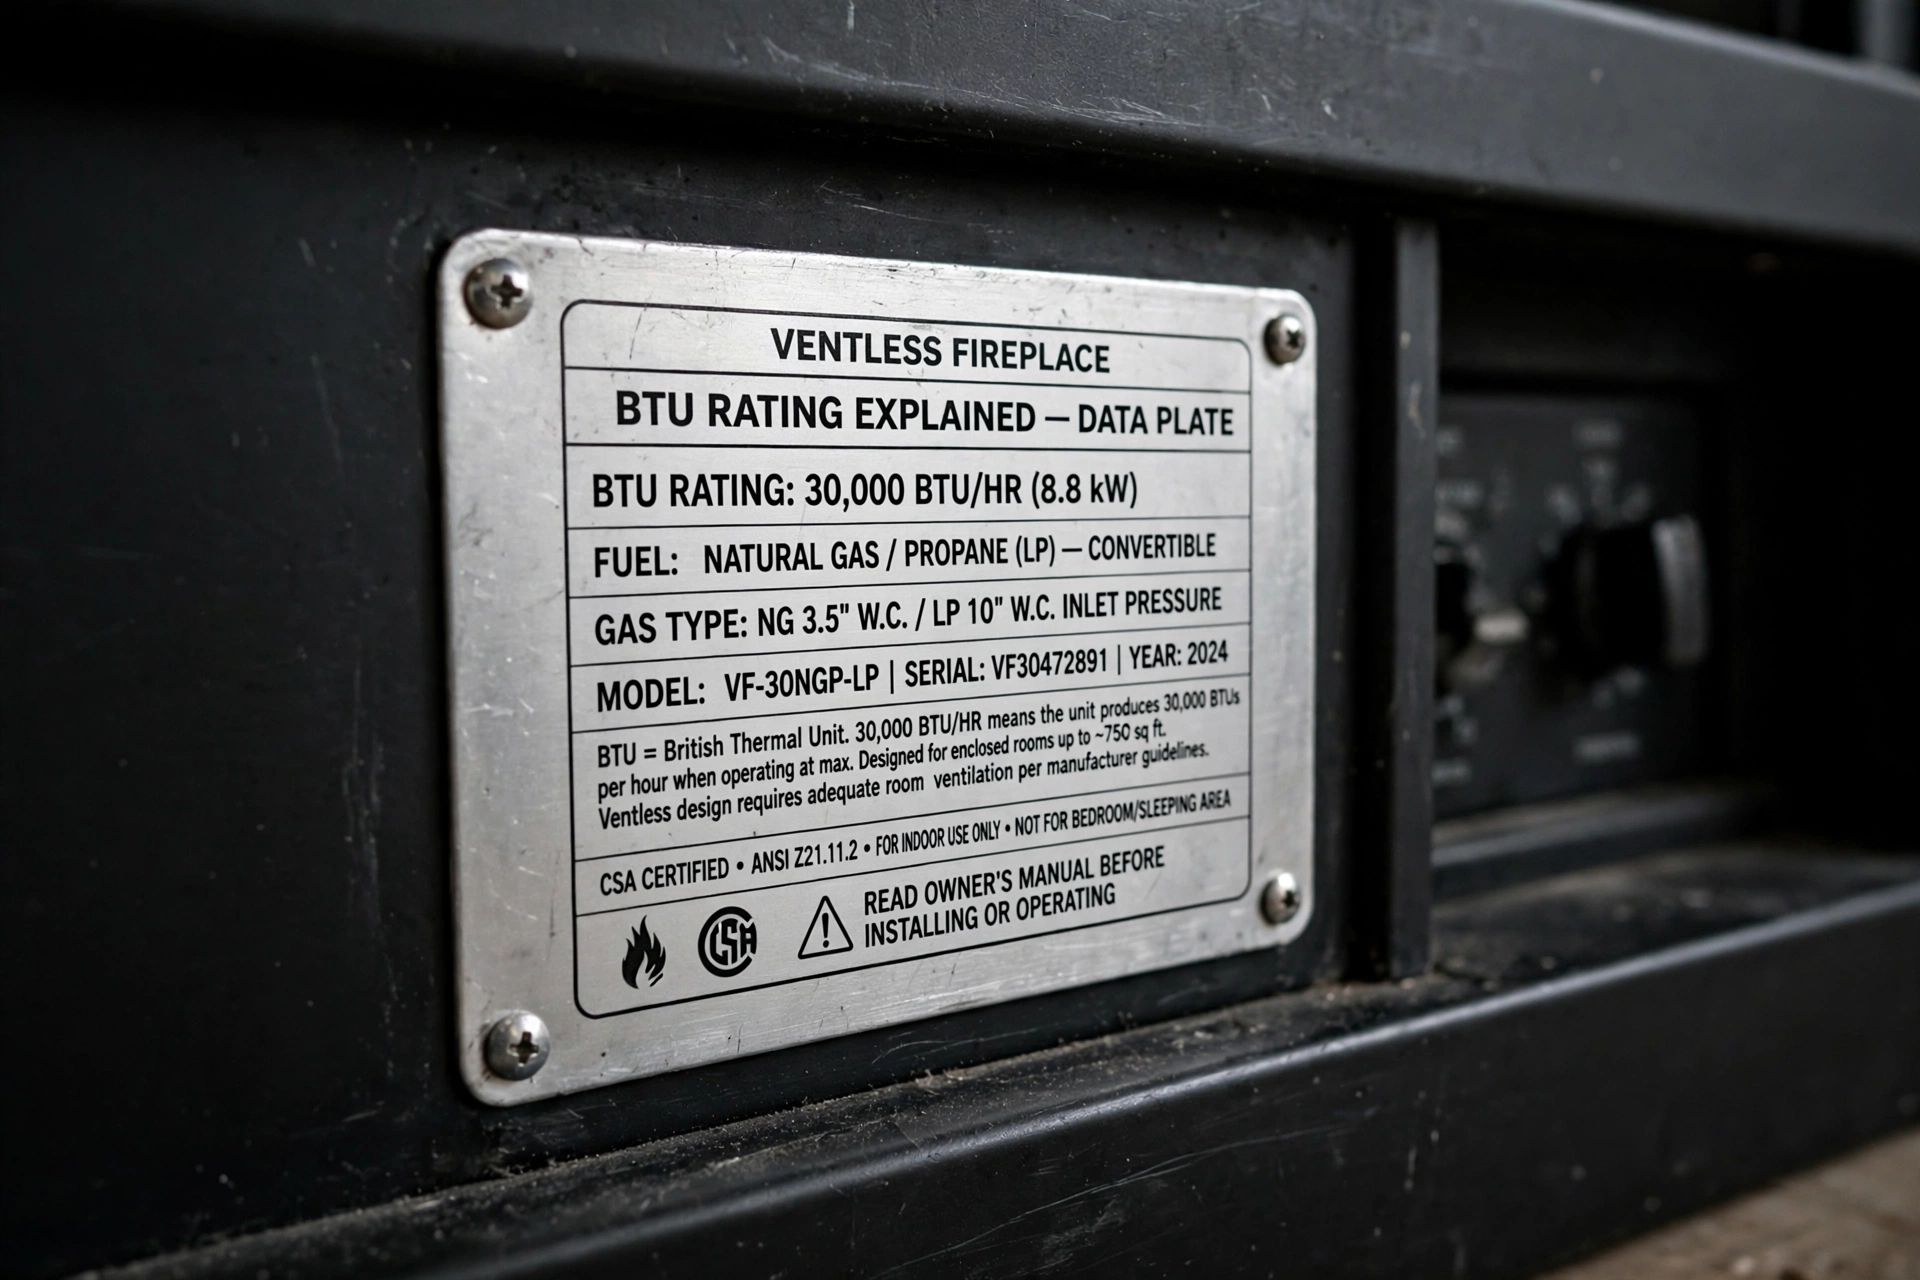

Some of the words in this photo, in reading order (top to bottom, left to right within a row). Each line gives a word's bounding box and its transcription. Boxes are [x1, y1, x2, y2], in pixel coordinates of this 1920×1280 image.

[770, 328, 942, 366] VENTLESS
[953, 337, 1110, 373] FIREPLACE
[616, 390, 693, 427] BTU
[708, 393, 842, 429] RATING
[856, 397, 1036, 432] EXPLAINED
[1079, 404, 1148, 434] DATA
[1157, 406, 1234, 436] PLATE
[593, 473, 657, 508] BTU
[670, 473, 794, 507] RATING:
[805, 473, 905, 513] 30,000
[915, 471, 1022, 509] BTU/HR
[1032, 471, 1081, 509] (8.8
[1090, 471, 1137, 509] kW)
[594, 546, 678, 578] FUEL:
[704, 542, 824, 574] NATURAL
[831, 540, 879, 570] GAS
[905, 538, 1008, 567] PROPANE
[1016, 535, 1055, 568] (LP)
[1088, 533, 1216, 561] CONVERTIBLE
[595, 612, 657, 646] GAS
[665, 608, 747, 641] TYPE:
[758, 606, 794, 636] NG
[802, 603, 849, 634] 3.5"
[857, 601, 908, 630] W.C.
[933, 599, 960, 626] LP
[968, 596, 1003, 624] 10"
[1010, 594, 1055, 622] W.C.
[1063, 591, 1119, 619] INLET
[1125, 586, 1222, 615] PRESSURE
[597, 676, 705, 713] MODEL:
[724, 664, 879, 701] VF-30NGP-LP
[905, 657, 985, 687] SERIAL:
[991, 648, 1106, 680] VF30472891
[1129, 643, 1182, 669] YEAR:
[1187, 639, 1228, 665] 2024
[597, 742, 636, 768] BTU
[664, 734, 724, 762] British
[729, 726, 802, 755] Thermal
[809, 723, 849, 747] Unit.
[855, 717, 913, 744] 30,000
[919, 711, 982, 736] BTU/HR
[988, 710, 1036, 729] means
[1040, 704, 1064, 724] the
[1069, 701, 1095, 721] unit
[1100, 697, 1160, 722] produces
[1164, 690, 1206, 712] 30,000
[1210, 688, 1240, 707] BTUs
[598, 780, 626, 804] per
[631, 773, 668, 795] hour
[673, 767, 716, 790] when
[721, 759, 794, 788] operating
[799, 756, 815, 777] at
[819, 756, 854, 774] max.
[859, 743, 924, 770] Designed
[927, 742, 948, 762] for
[951, 735, 1009, 760] enclosed
[1014, 735, 1055, 753] rooms
[1058, 733, 1074, 751] up
[1078, 729, 1091, 746] to
[1095, 723, 1131, 742] ~750
[1134, 725, 1149, 743] sq
[1153, 719, 1166, 737] ft.
[598, 802, 672, 830] Ventless
[676, 795, 732, 821] design
[737, 787, 803, 815] requires
[807, 778, 880, 805] adequate
[886, 776, 924, 795] room
[933, 763, 1013, 789] ventilation
[1018, 762, 1042, 783] per
[1047, 751, 1138, 775] manufacturer
[1142, 743, 1209, 769] guidelines.
[600, 869, 637, 896] CSA
[642, 857, 729, 890] CERTIFIED
[751, 848, 789, 874] ANSI
[794, 839, 858, 868] Z21.11.2
[876, 834, 899, 856] FOR
[902, 827, 945, 853] INDOOR
[948, 824, 969, 846] USE
[972, 820, 1001, 843] ONLY
[1015, 814, 1041, 836] NOT
[1044, 811, 1068, 832] FOR
[1072, 793, 1197, 829] BEDROOM/SLEEPING
[1200, 789, 1231, 810] AREA
[864, 884, 918, 916] READ
[924, 869, 1013, 905] OWNER'S
[1019, 857, 1095, 890] MANUAL
[1100, 845, 1165, 877] BEFORE
[865, 906, 978, 948] INSTALLING
[984, 900, 1010, 926] OR
[1016, 883, 1115, 921] OPERATING
